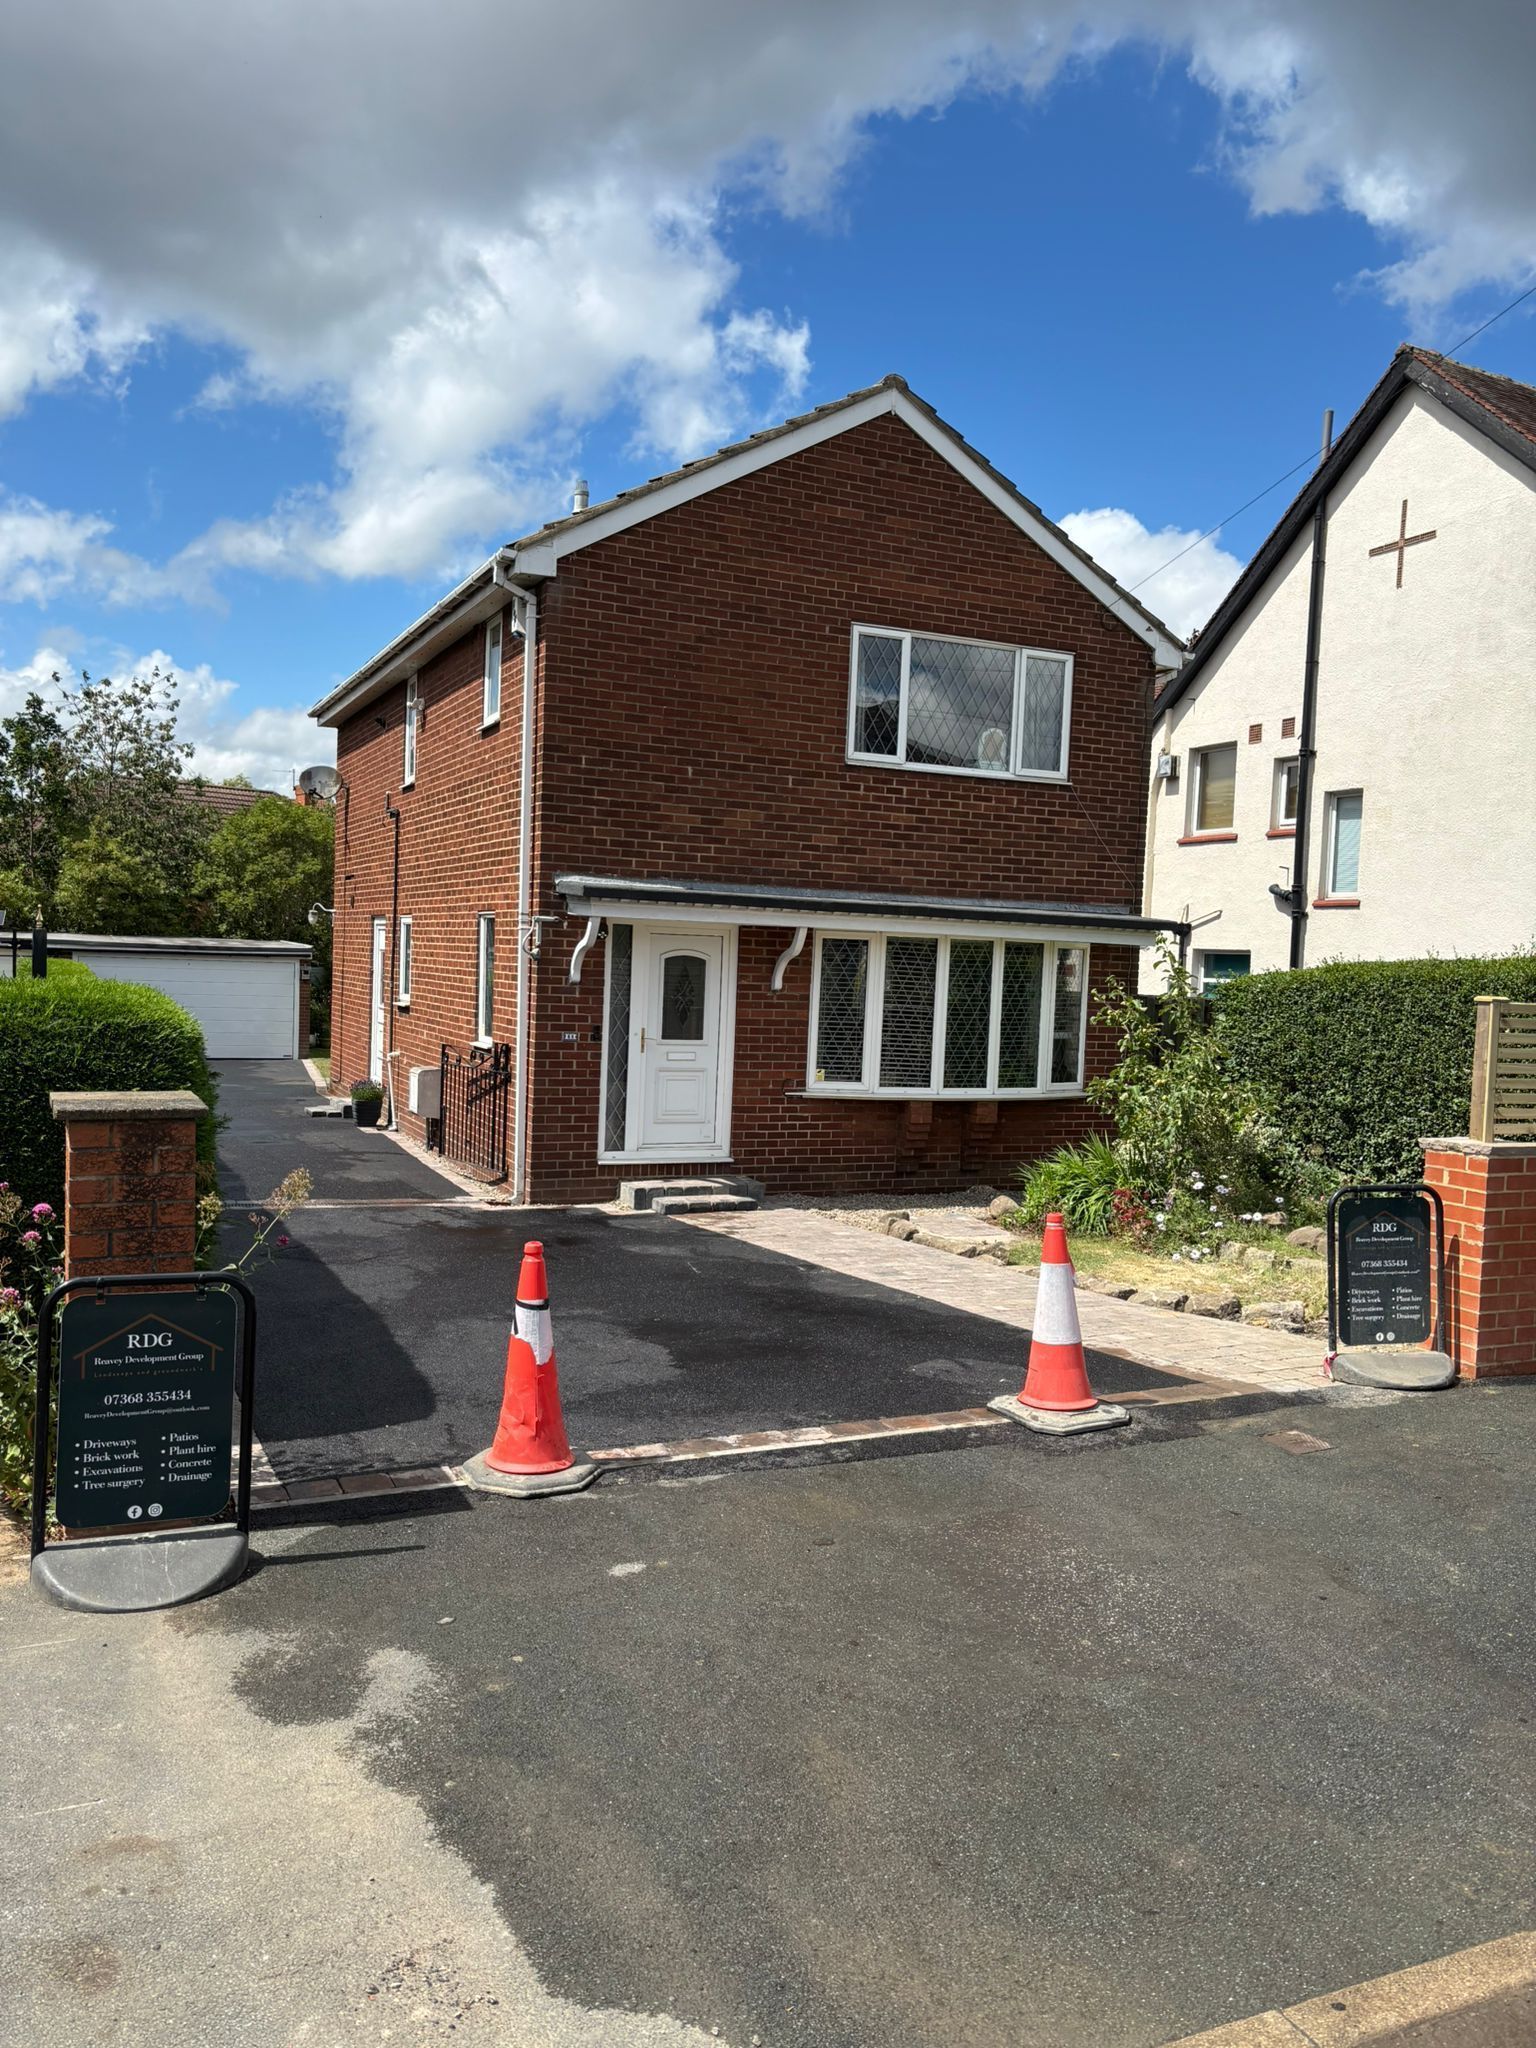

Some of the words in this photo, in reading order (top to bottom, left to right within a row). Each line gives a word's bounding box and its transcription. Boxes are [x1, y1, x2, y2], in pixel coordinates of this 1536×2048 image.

[1372, 1223, 1397, 1233] RDG
[126, 1332, 173, 1349] RDG
[94, 1356, 123, 1366] Reavey
[125, 1354, 177, 1365] Development
[178, 1352, 204, 1361] Group
[104, 1392, 143, 1406] 07368
[146, 1389, 192, 1402] 355434
[169, 1432, 199, 1442] Patios
[83, 1438, 137, 1450] Driveways
[169, 1446, 196, 1456] Plant
[197, 1444, 217, 1453] hire
[83, 1452, 111, 1463] Brick
[113, 1450, 140, 1461] work
[168, 1458, 212, 1469] Concrete
[82, 1464, 143, 1477] Excavations
[168, 1472, 213, 1483] Drainage
[82, 1480, 105, 1490] Tree
[107, 1478, 146, 1489] surgery
